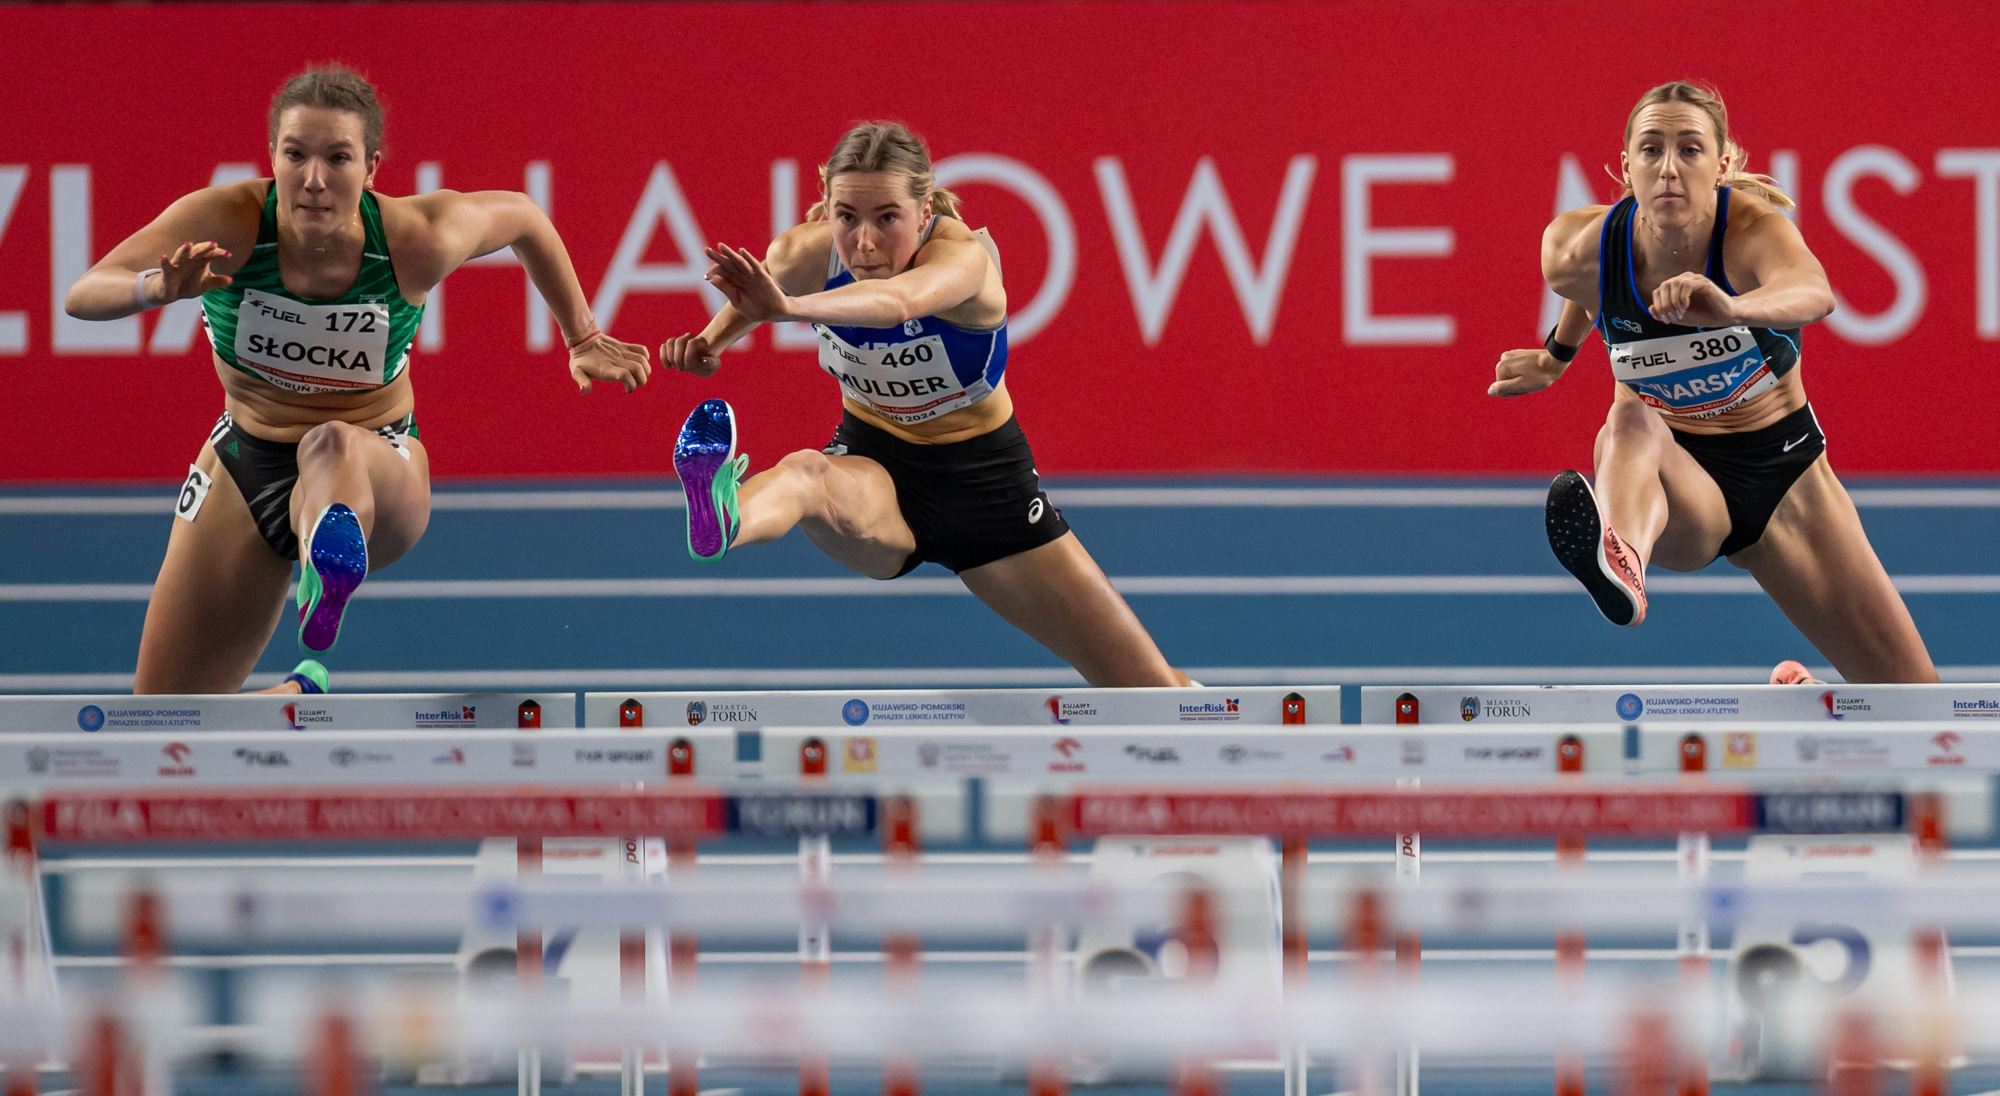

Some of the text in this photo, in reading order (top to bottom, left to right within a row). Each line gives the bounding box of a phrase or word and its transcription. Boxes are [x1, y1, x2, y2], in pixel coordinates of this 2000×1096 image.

[261, 305, 307, 325] FUEL
[325, 312, 376, 333] 172
[247, 334, 372, 372] SŁOCKA
[831, 341, 867, 366] FUEL
[1689, 334, 1742, 361] 380
[881, 343, 933, 370] 460
[1630, 352, 1677, 369] FUEL
[267, 375, 311, 392] TORUŃ
[1644, 397, 1657, 406] 68.
[1745, 368, 1766, 388] Polski
[905, 410, 936, 422] 2024
[178, 471, 202, 513] 6
[1607, 526, 1623, 555] new
[871, 703, 965, 712] KUJAWSKO-POMORSKI
[1179, 704, 1225, 713] InterRisk
[1645, 697, 1739, 705] KUJAWSKO-POMORSKI
[1953, 700, 1999, 709] InterRisk
[107, 709, 201, 718] KUJAWSKO-POMORSKI
[415, 711, 462, 720] InterRisk
[710, 708, 758, 722] TORUŃ
[872, 713, 903, 721] ZWIĄZEK
[1484, 703, 1531, 717] TORUŃ
